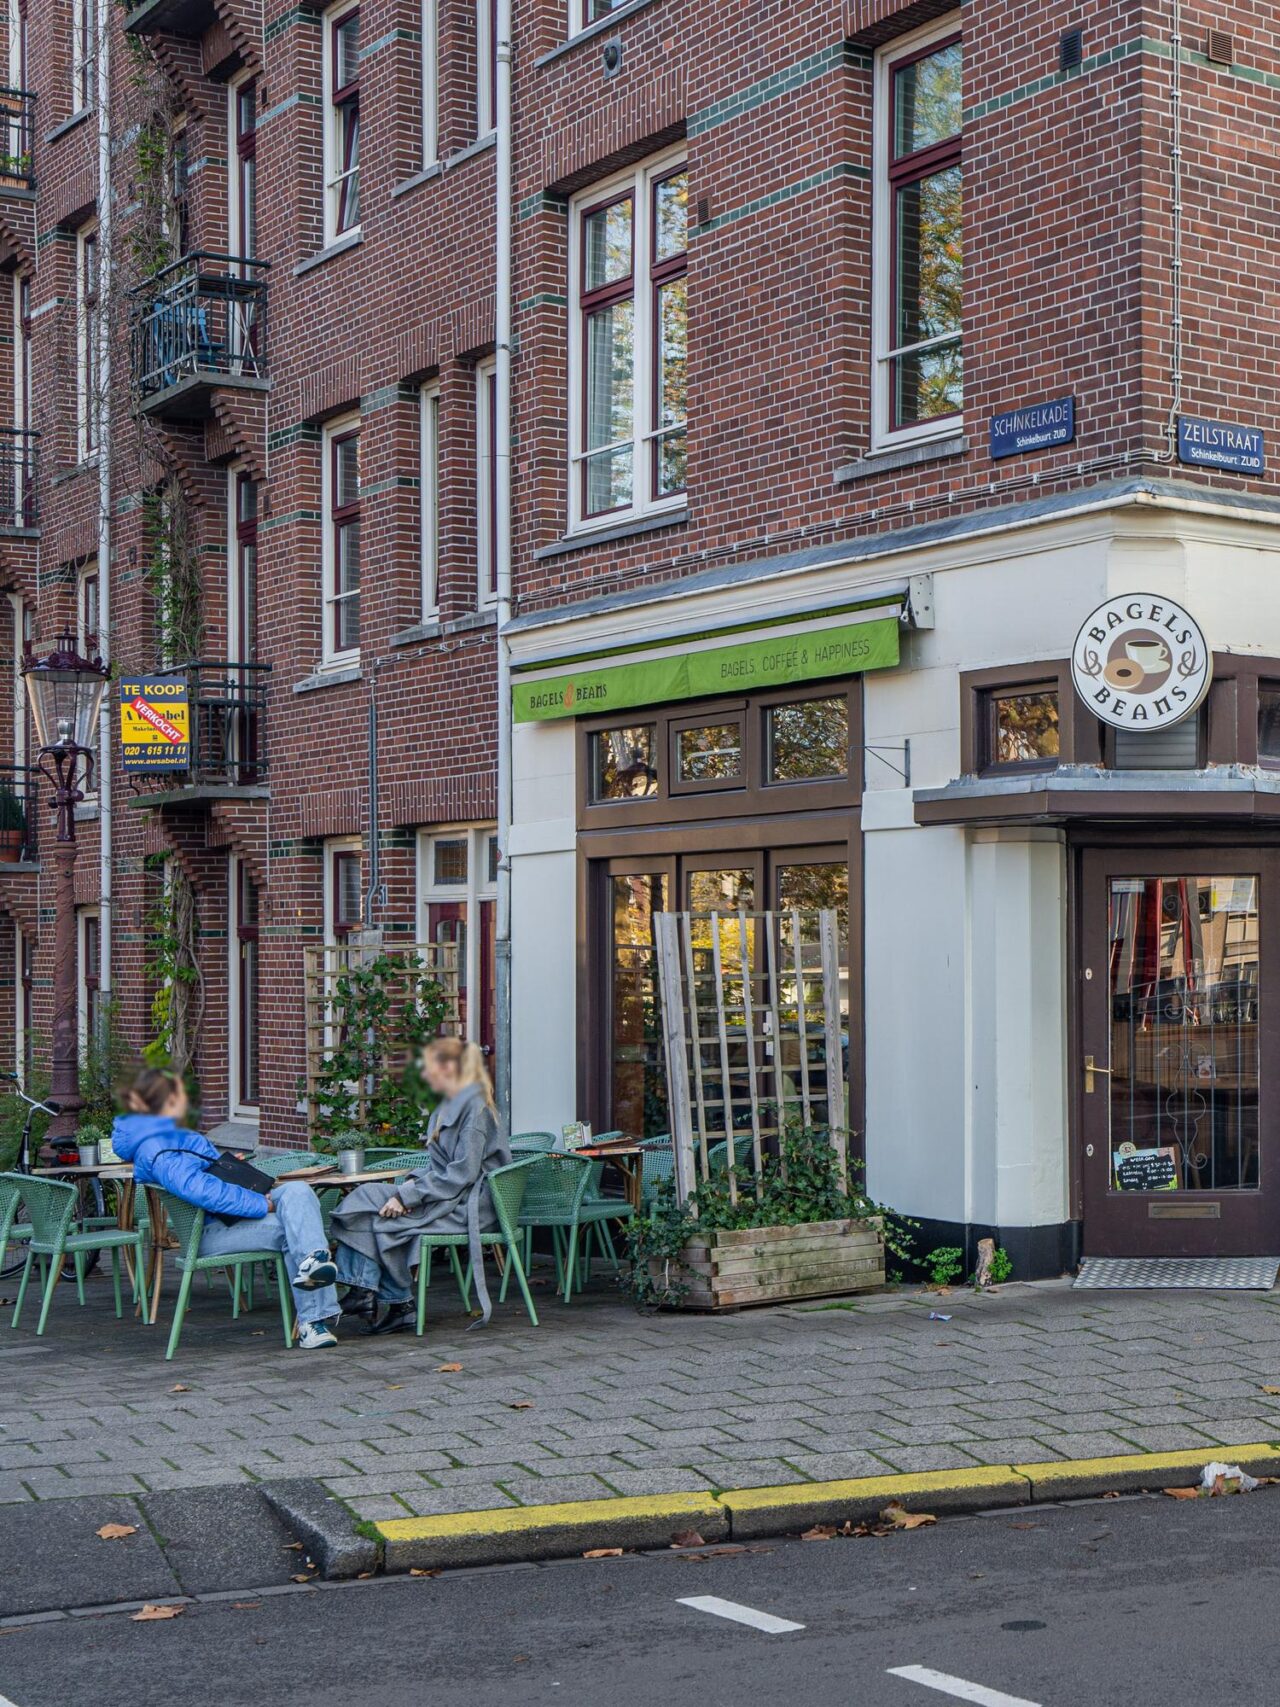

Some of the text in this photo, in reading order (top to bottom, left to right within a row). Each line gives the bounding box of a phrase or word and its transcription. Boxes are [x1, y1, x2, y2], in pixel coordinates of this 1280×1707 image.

[994, 404, 1069, 437] SCHINKELKADE
[1016, 428, 1067, 448] Schinkelbuurt ZUID
[1183, 423, 1260, 452] ZEILSTRAAT
[1191, 447, 1260, 468] Schinkelbuurt ZUID
[1088, 603, 1192, 645] BAGELS
[762, 649, 799, 672] COFFEE
[800, 649, 808, 664] &
[814, 639, 870, 663] HAPPINESS
[122, 684, 185, 696] TE KOOP
[530, 690, 564, 709] BAGELS
[576, 683, 608, 701] BEANS
[1093, 685, 1188, 721] BEANS
[135, 700, 181, 741] VERKOCHT
[124, 745, 140, 756] 020
[147, 745, 162, 756] 615
[165, 745, 174, 756] 11
[177, 745, 187, 755] 11
